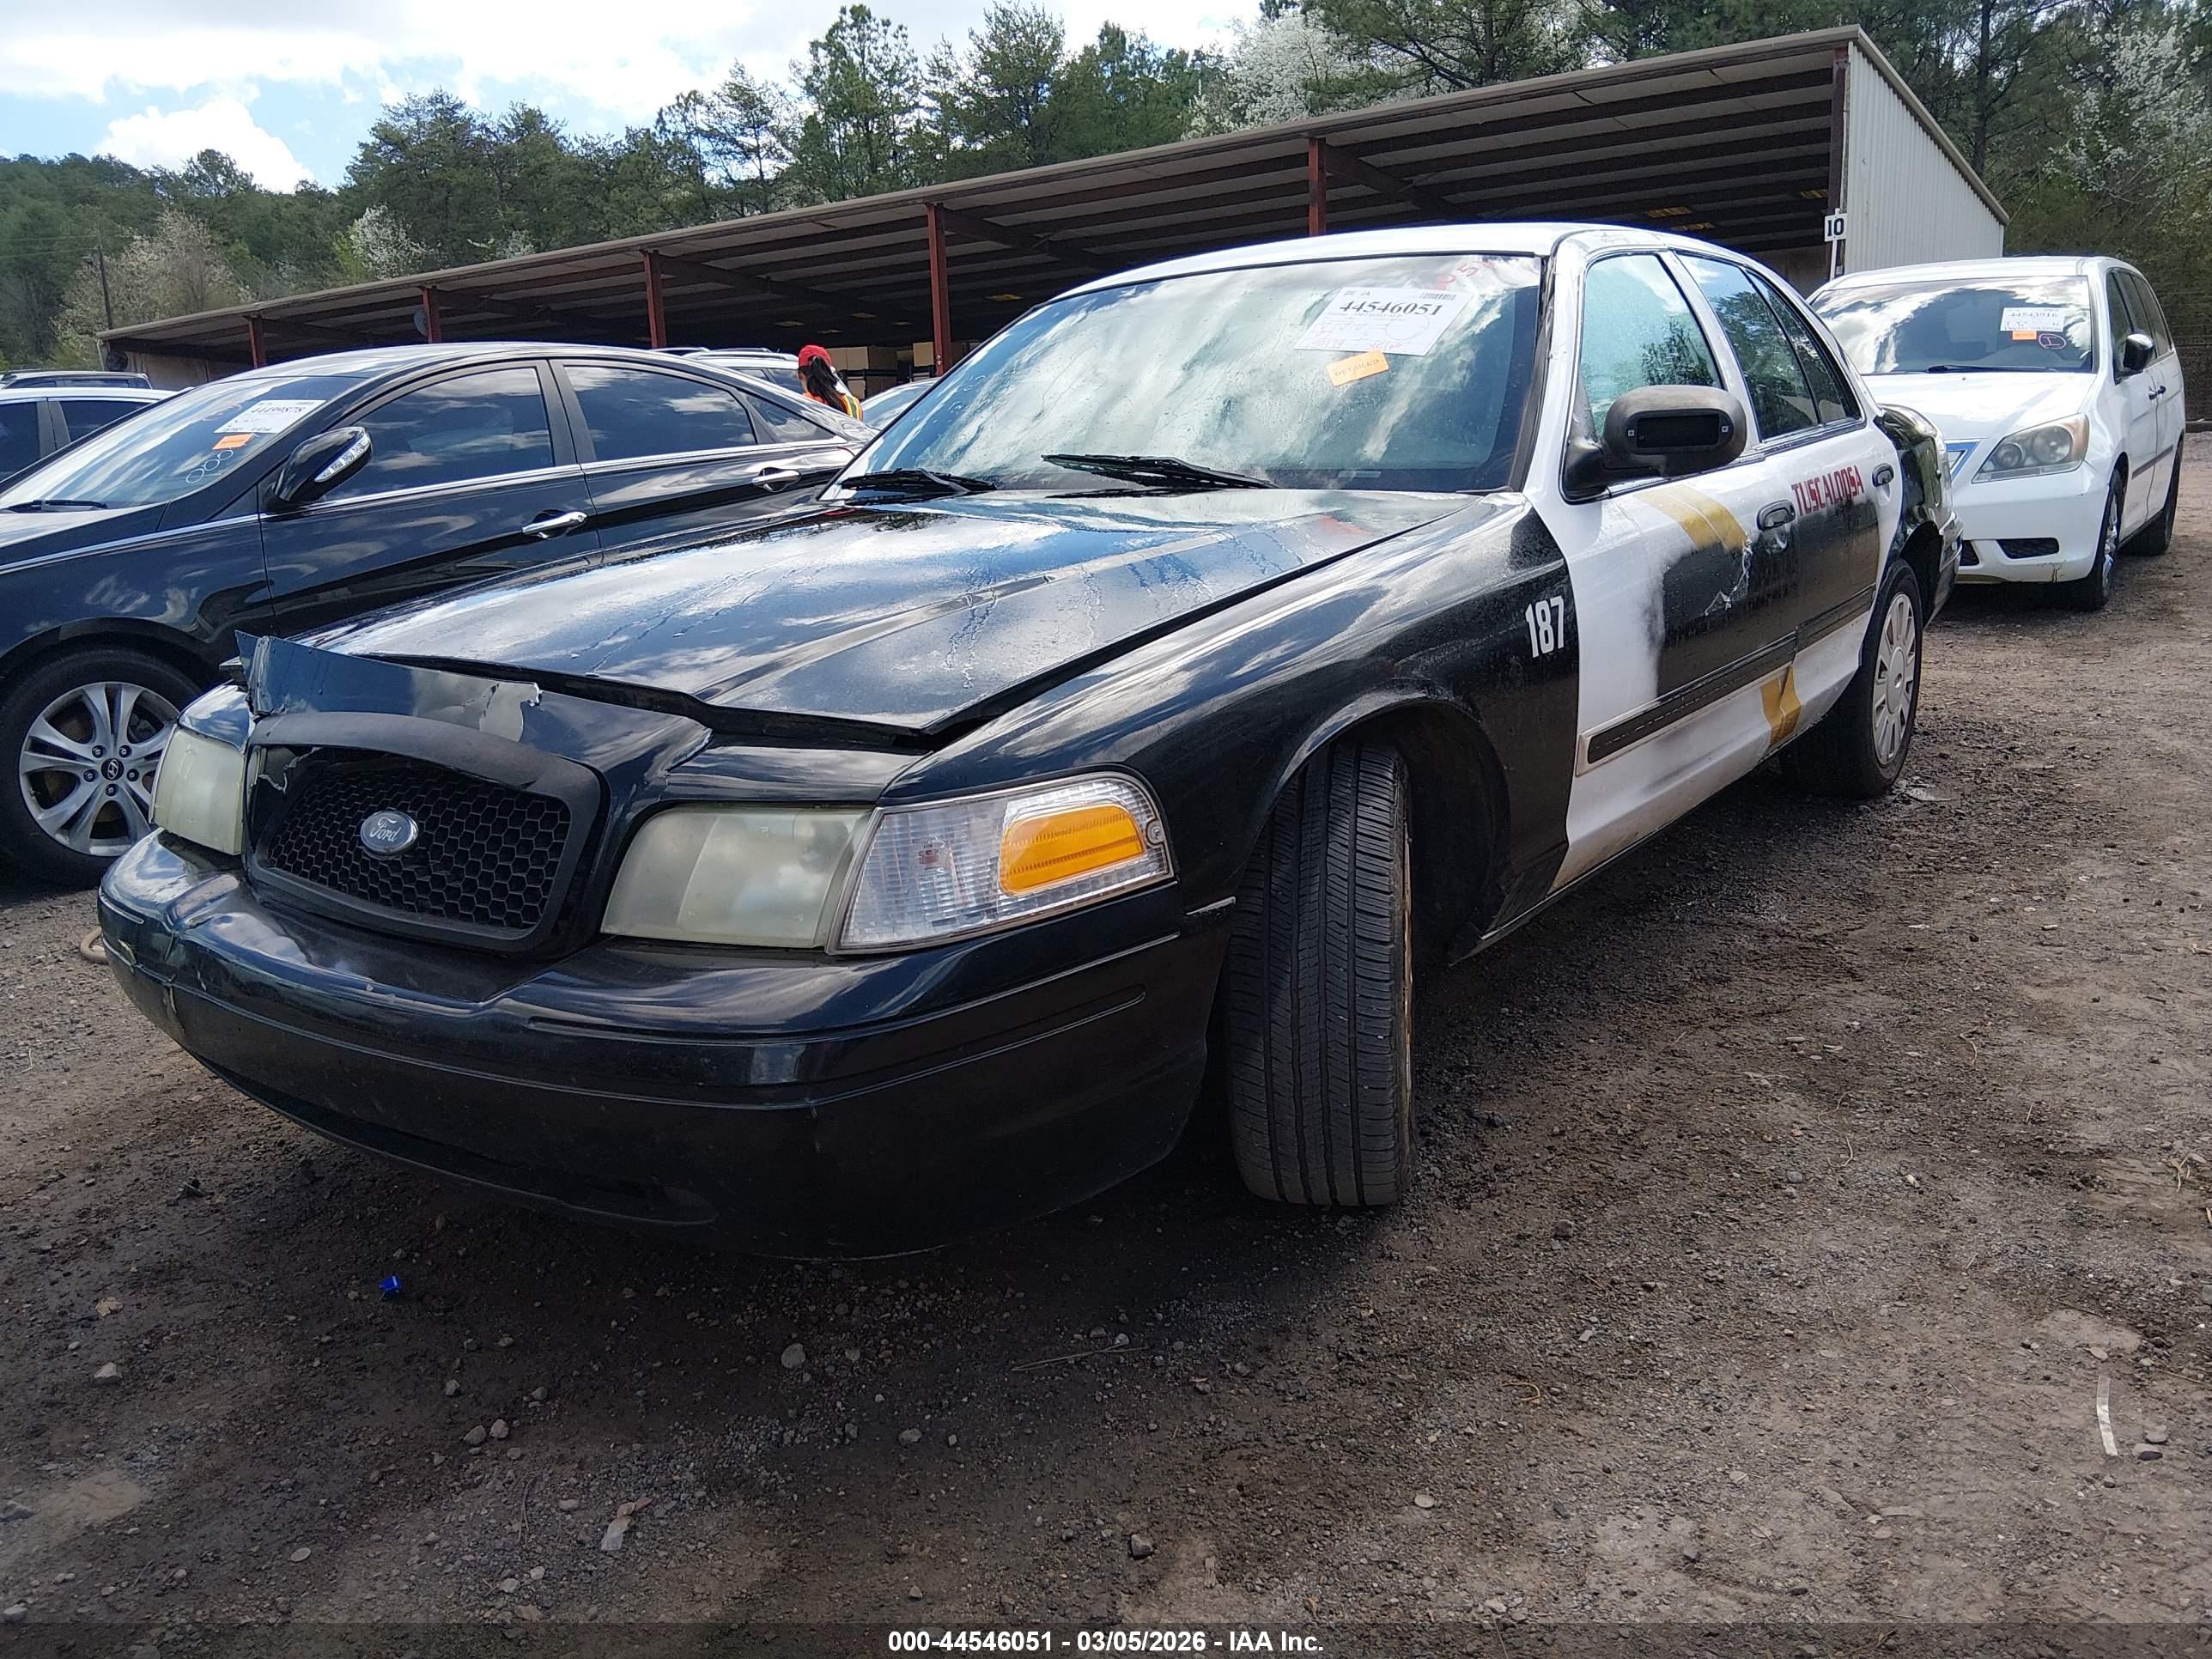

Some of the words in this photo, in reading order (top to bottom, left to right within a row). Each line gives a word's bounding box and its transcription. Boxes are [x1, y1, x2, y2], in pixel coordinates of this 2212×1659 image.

[1826, 217, 1844, 237] 10
[1339, 301, 1443, 316] 44546051
[1790, 465, 1865, 517] TUSCALOOSA
[1525, 595, 1565, 659] 187
[369, 817, 398, 843] Ford
